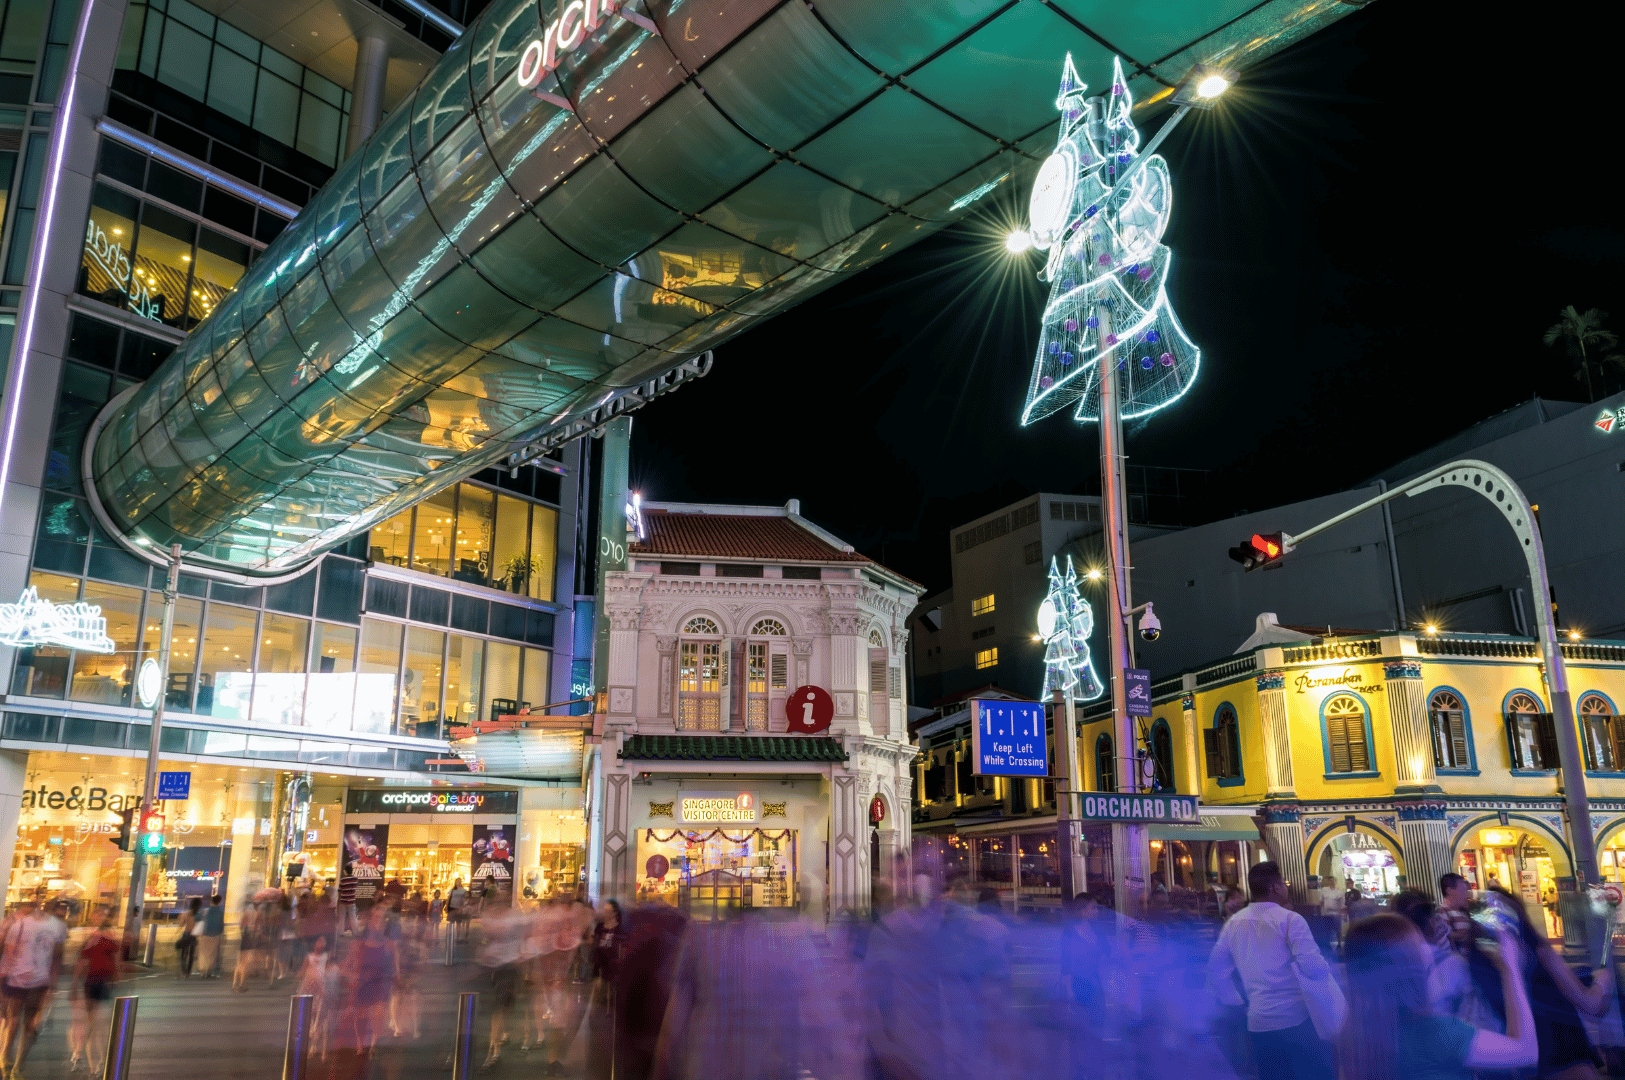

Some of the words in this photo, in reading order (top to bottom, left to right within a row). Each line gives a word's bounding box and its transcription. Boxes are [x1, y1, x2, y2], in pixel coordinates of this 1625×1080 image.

[1294, 668, 1362, 694] Peranakan
[993, 742, 1012, 755] Keep
[1016, 743, 1033, 753] Left
[984, 755, 1004, 766] While
[1008, 755, 1044, 769] Crossing
[381, 791, 485, 807] orchardgateway
[683, 799, 735, 810] SINGAPORE
[445, 803, 475, 812] emerald
[1085, 796, 1165, 819] ORCHARD
[1170, 799, 1193, 819] RD
[683, 810, 718, 820] VISITOR
[721, 810, 755, 820] CENTRE
